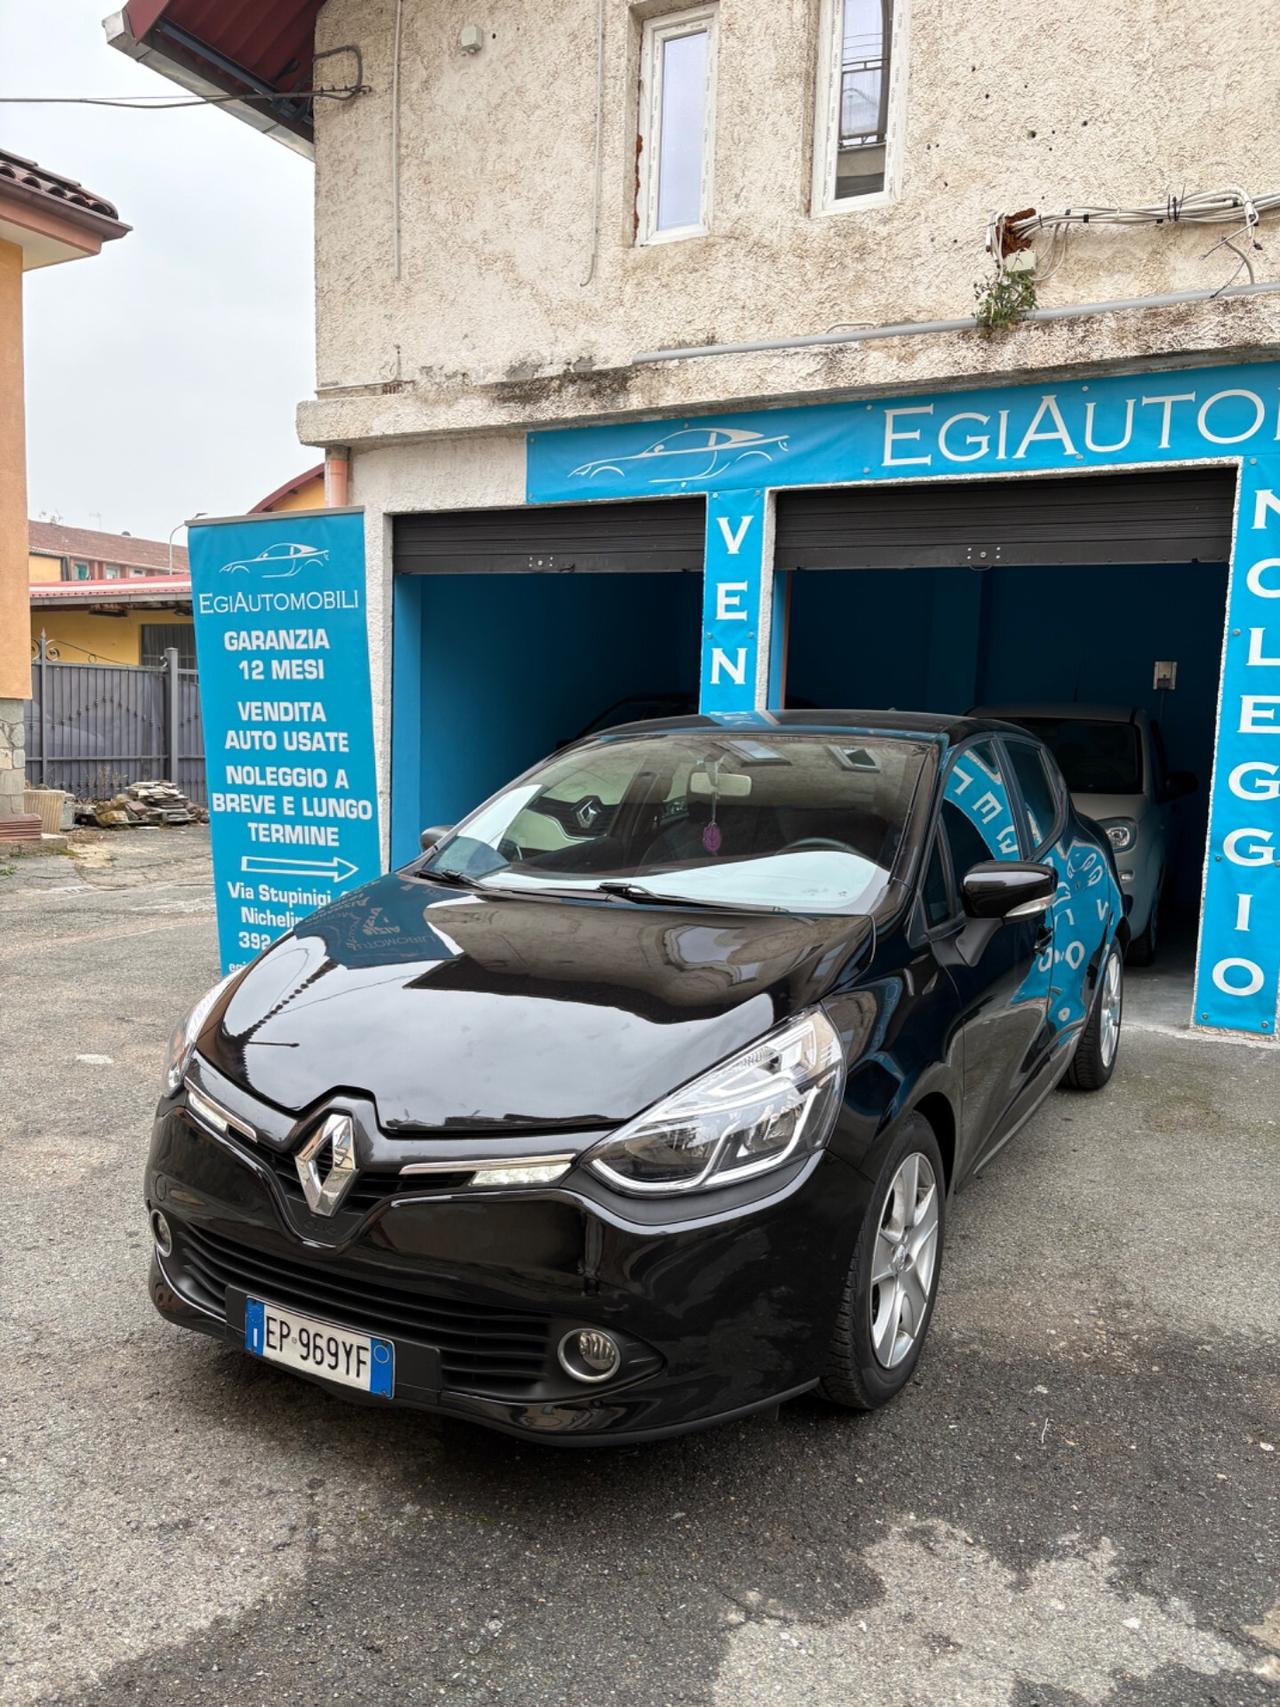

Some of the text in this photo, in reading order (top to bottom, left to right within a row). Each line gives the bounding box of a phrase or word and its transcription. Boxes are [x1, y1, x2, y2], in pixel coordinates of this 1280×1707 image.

[881, 387, 1280, 466] EGIAUTO
[710, 515, 754, 715] VEN
[224, 628, 330, 651] GARANZIA
[239, 659, 325, 680] 12 MESI
[238, 701, 327, 722] VENDITA
[225, 730, 350, 753] AUTO USATE
[226, 765, 349, 789] NOLEGGIO A
[212, 793, 373, 820] BREVE E LUNGO
[248, 823, 340, 847] TERMINE
[227, 881, 255, 899] Via
